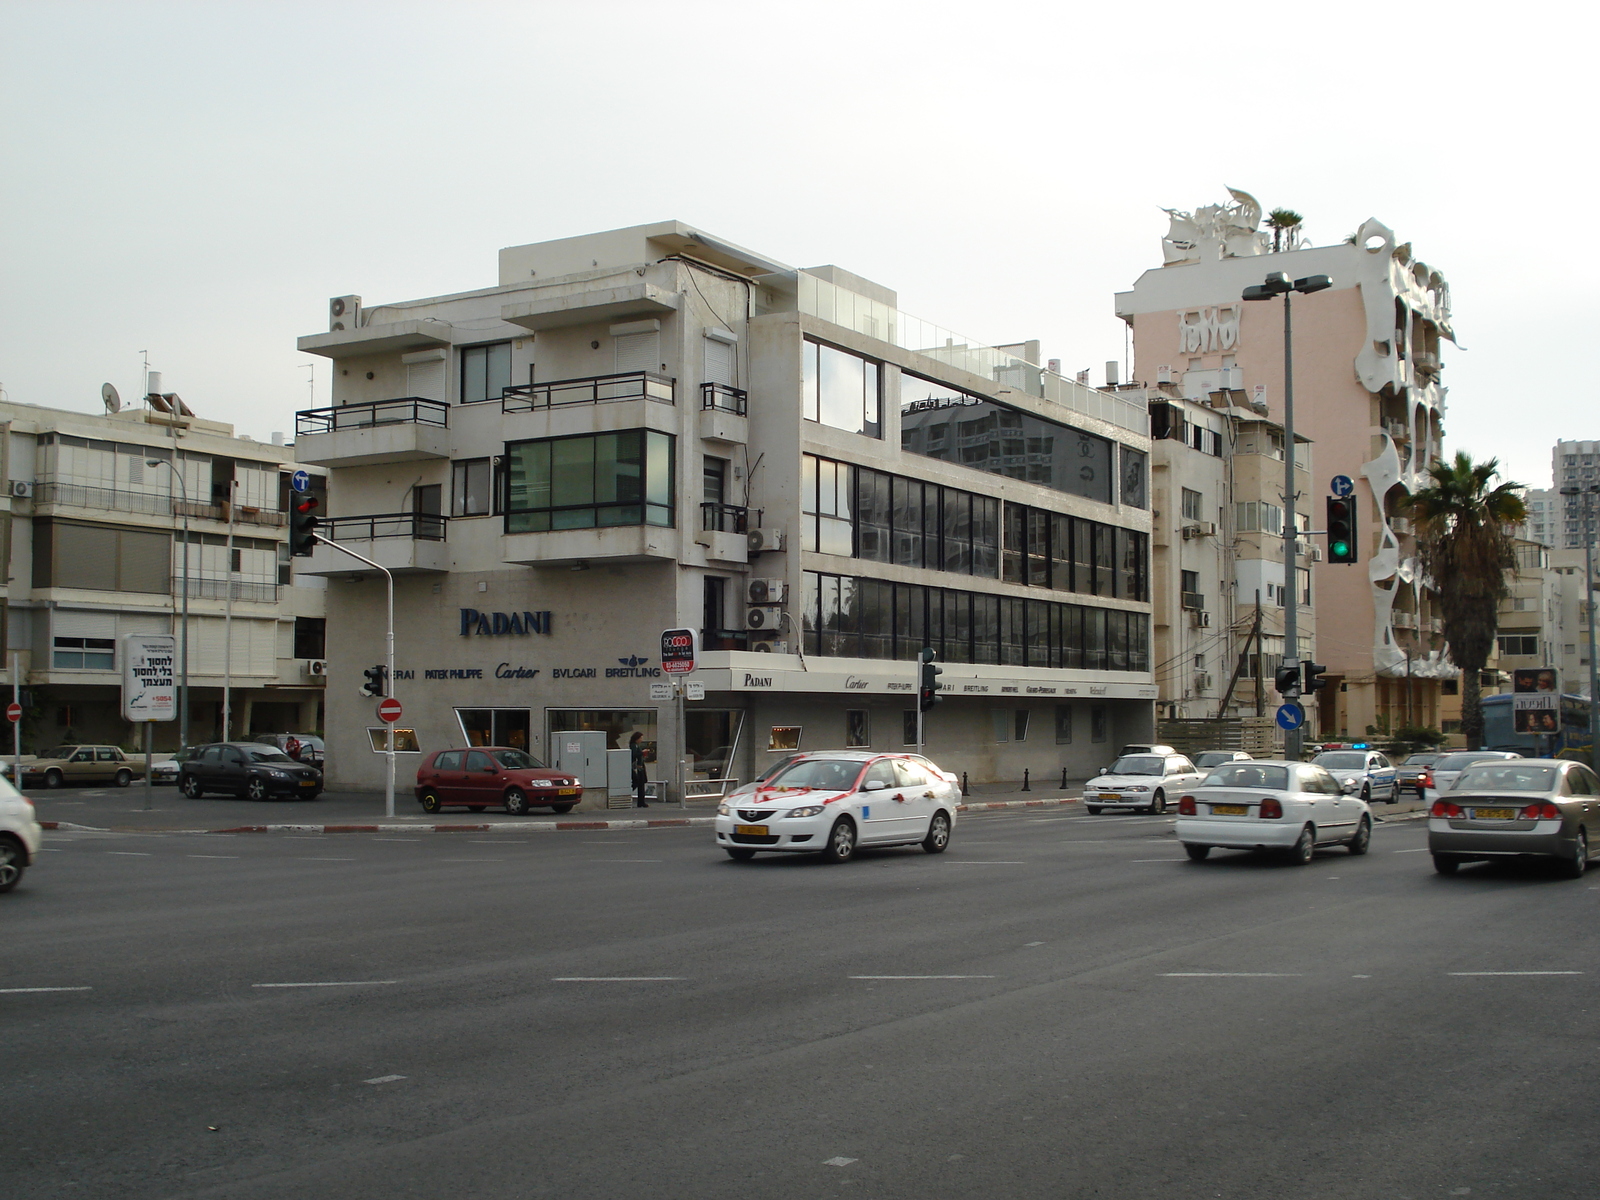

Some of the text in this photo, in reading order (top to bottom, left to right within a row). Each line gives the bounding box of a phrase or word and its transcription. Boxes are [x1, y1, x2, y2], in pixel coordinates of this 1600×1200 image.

[460, 608, 552, 636] PADANI
[147, 656, 172, 667] לחסוך
[133, 666, 173, 677] בלי לחסוך
[425, 669, 483, 679] PATEK PHILIPPE
[494, 662, 540, 679] Cartier
[553, 668, 596, 679] BVLGARI
[605, 667, 661, 678] BREITLING
[141, 678, 172, 688] מעצמך
[744, 673, 773, 687] PADANI
[845, 675, 869, 690] Cartier
[963, 684, 989, 692] BREITLING
